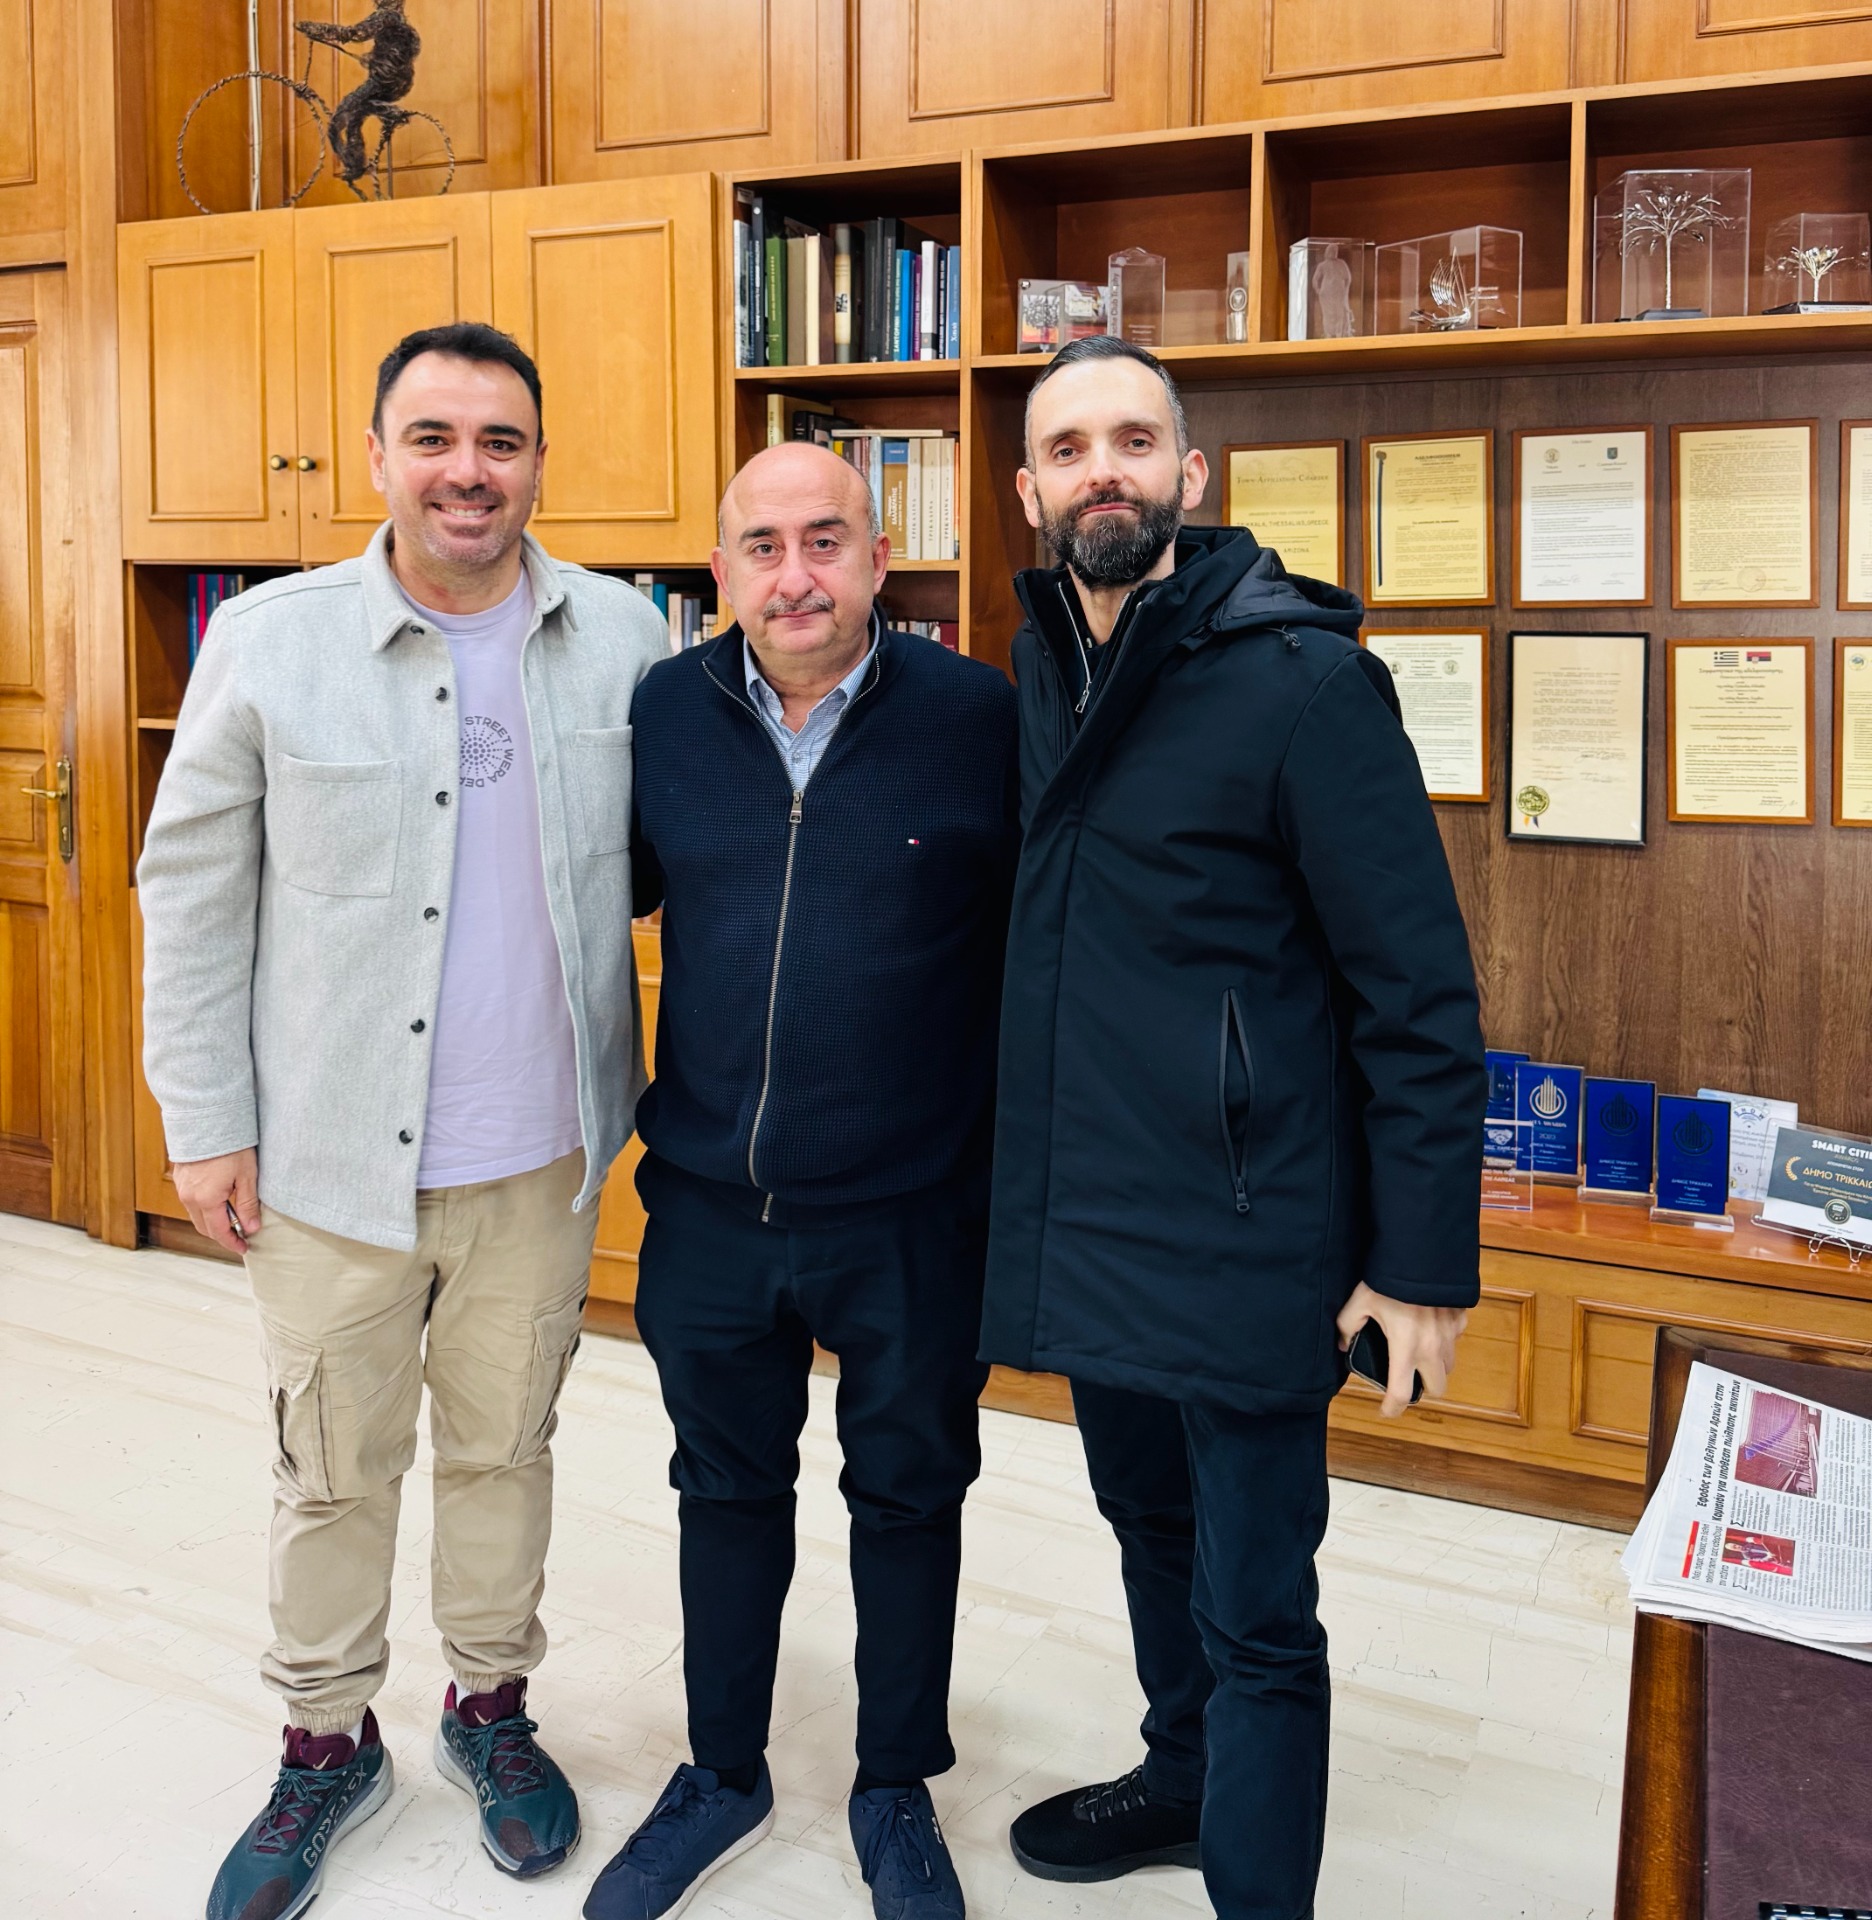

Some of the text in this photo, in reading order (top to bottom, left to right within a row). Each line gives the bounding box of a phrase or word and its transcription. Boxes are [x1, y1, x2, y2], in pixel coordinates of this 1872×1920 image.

[1111, 273, 1119, 297] Trphy
[464, 715, 513, 744] STREET
[487, 748, 514, 783] WERA
[1811, 1140, 1847, 1154] SMART
[1803, 1167, 1833, 1180] ΔΗΜΟ
[1695, 1383, 1724, 1507] Έφοδος των βελγικών Αρχών στην
[1711, 1379, 1741, 1521] Κομισιόν για υπόθεση πώλησης ακινήτων
